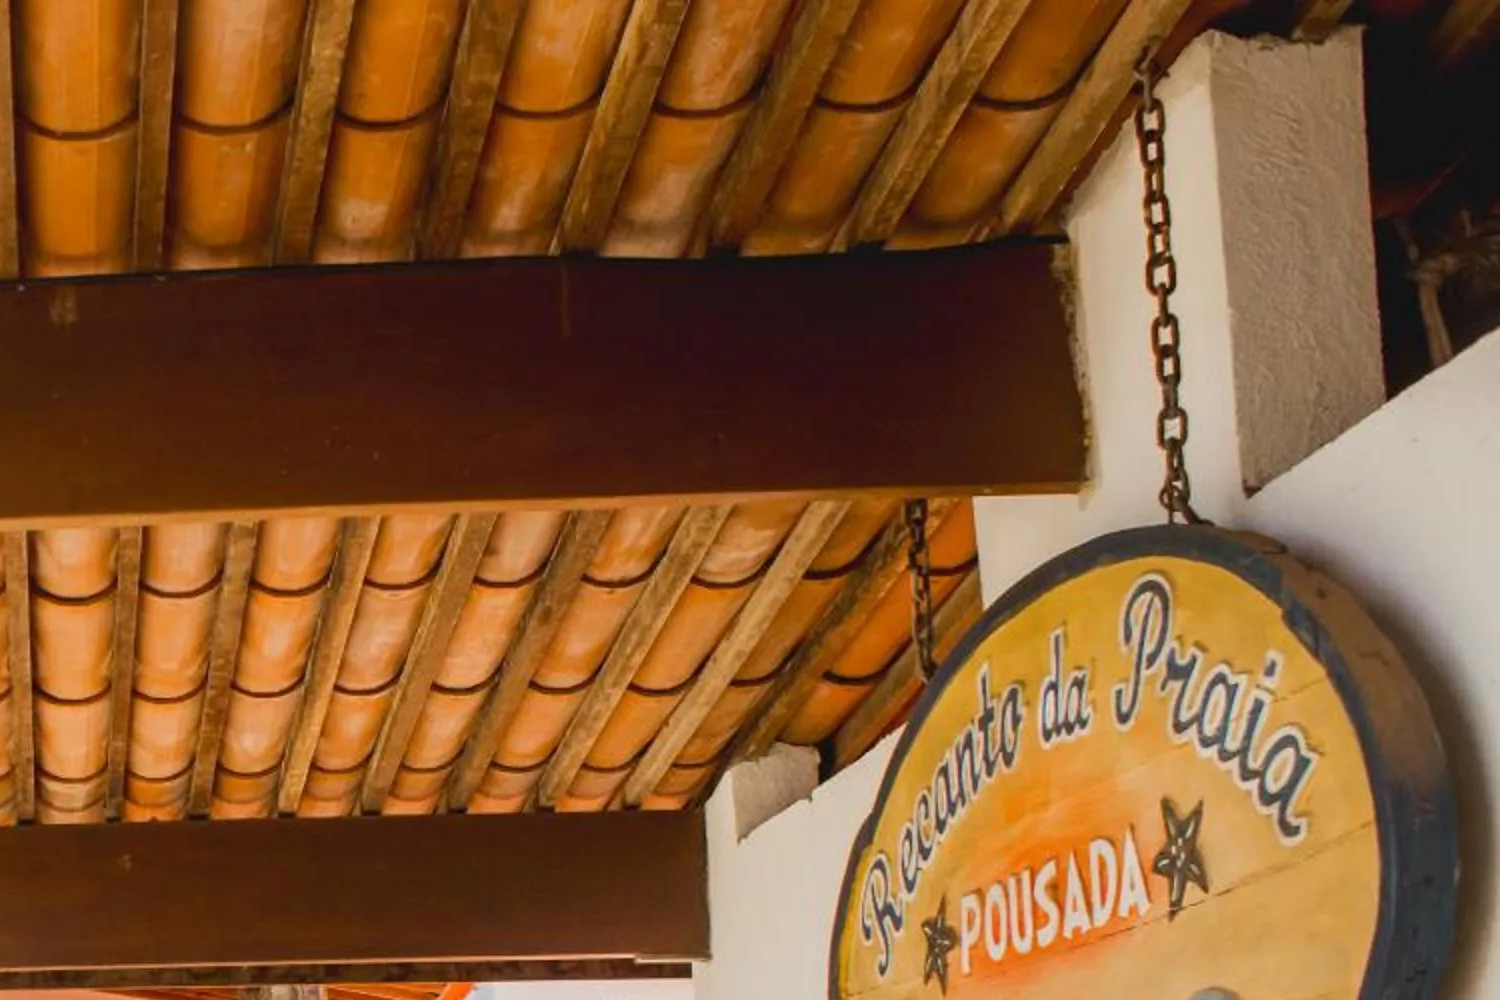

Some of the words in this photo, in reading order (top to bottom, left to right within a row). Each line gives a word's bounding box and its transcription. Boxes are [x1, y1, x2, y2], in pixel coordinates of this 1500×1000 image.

[860, 664, 1024, 978] Recanto
[1040, 628, 1092, 748] da
[1113, 573, 1316, 846] Praia
[960, 829, 1150, 975] POUSADA
